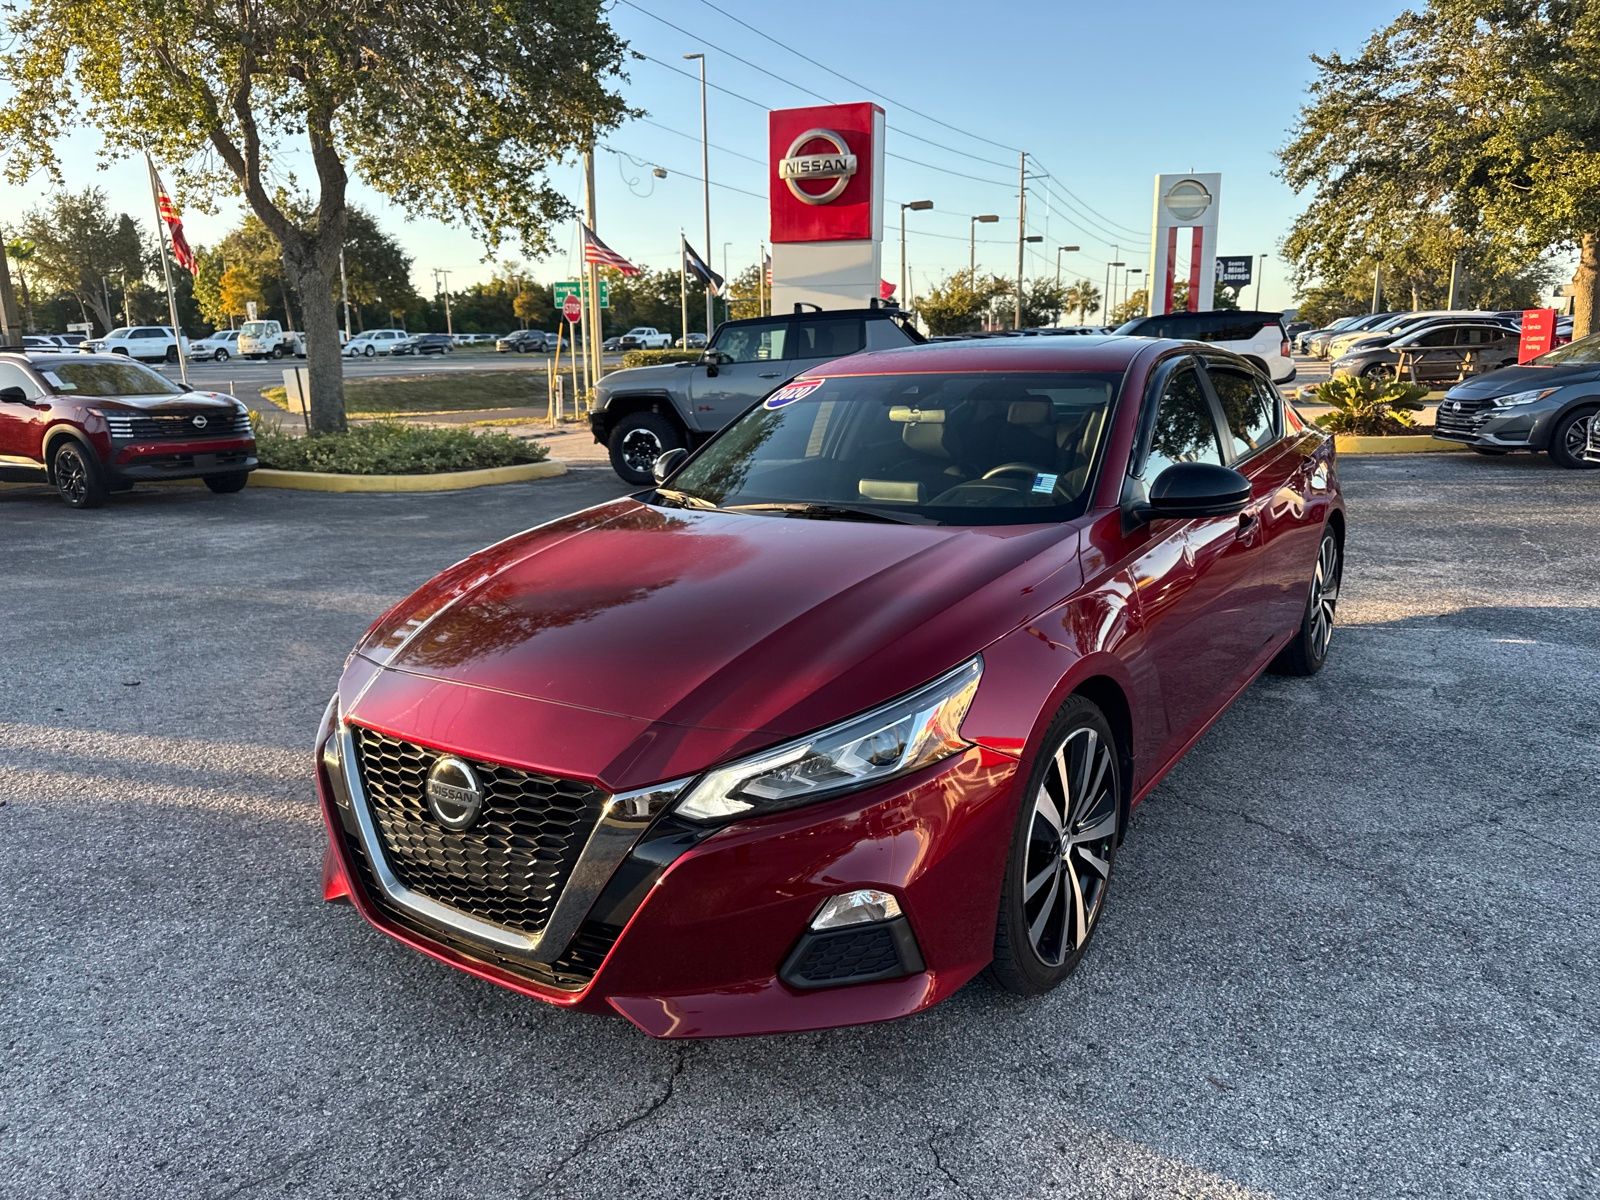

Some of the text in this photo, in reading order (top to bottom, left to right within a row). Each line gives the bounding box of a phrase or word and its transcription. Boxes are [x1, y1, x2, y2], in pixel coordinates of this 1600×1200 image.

[786, 159, 848, 173] NISSAN
[565, 303, 581, 314] STOP
[770, 386, 812, 401] 2020
[432, 784, 473, 803] NISSAN
